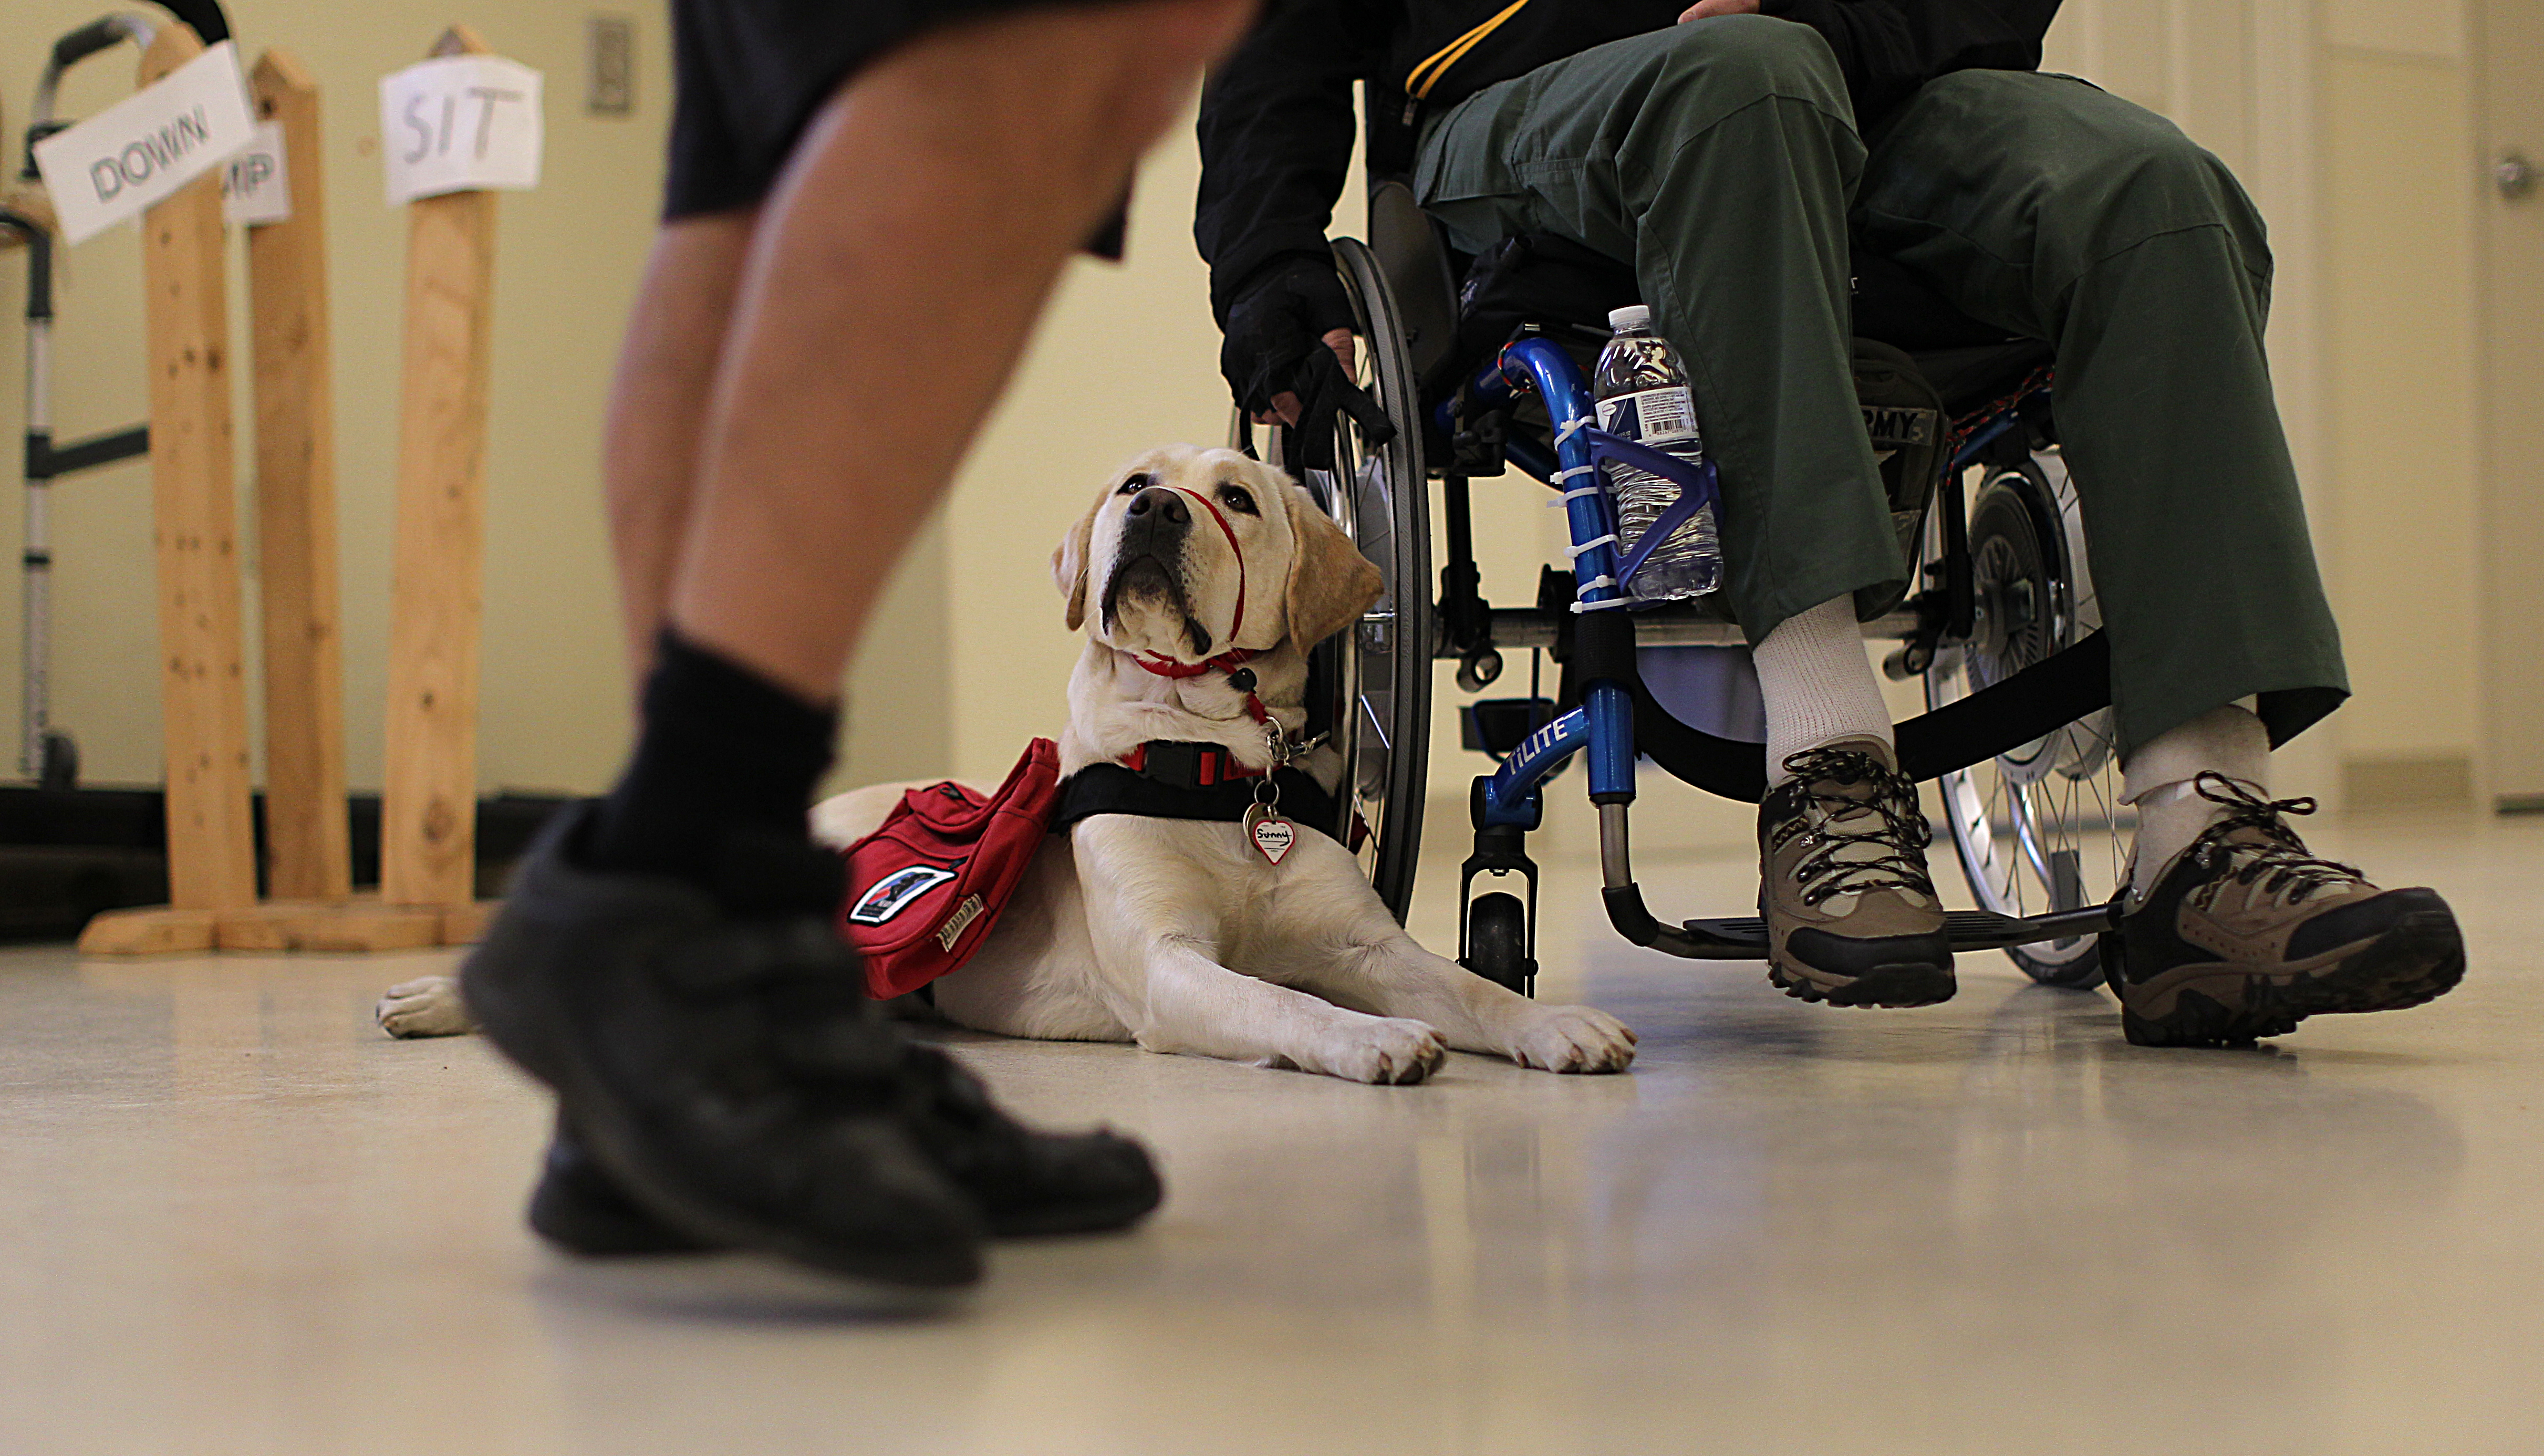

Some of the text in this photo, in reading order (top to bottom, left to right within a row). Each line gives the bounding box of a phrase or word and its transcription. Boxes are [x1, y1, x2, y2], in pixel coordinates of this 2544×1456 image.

[91, 105, 209, 203] DOWN
[403, 87, 524, 164] SIT
[1257, 828, 1290, 846] Sunny
